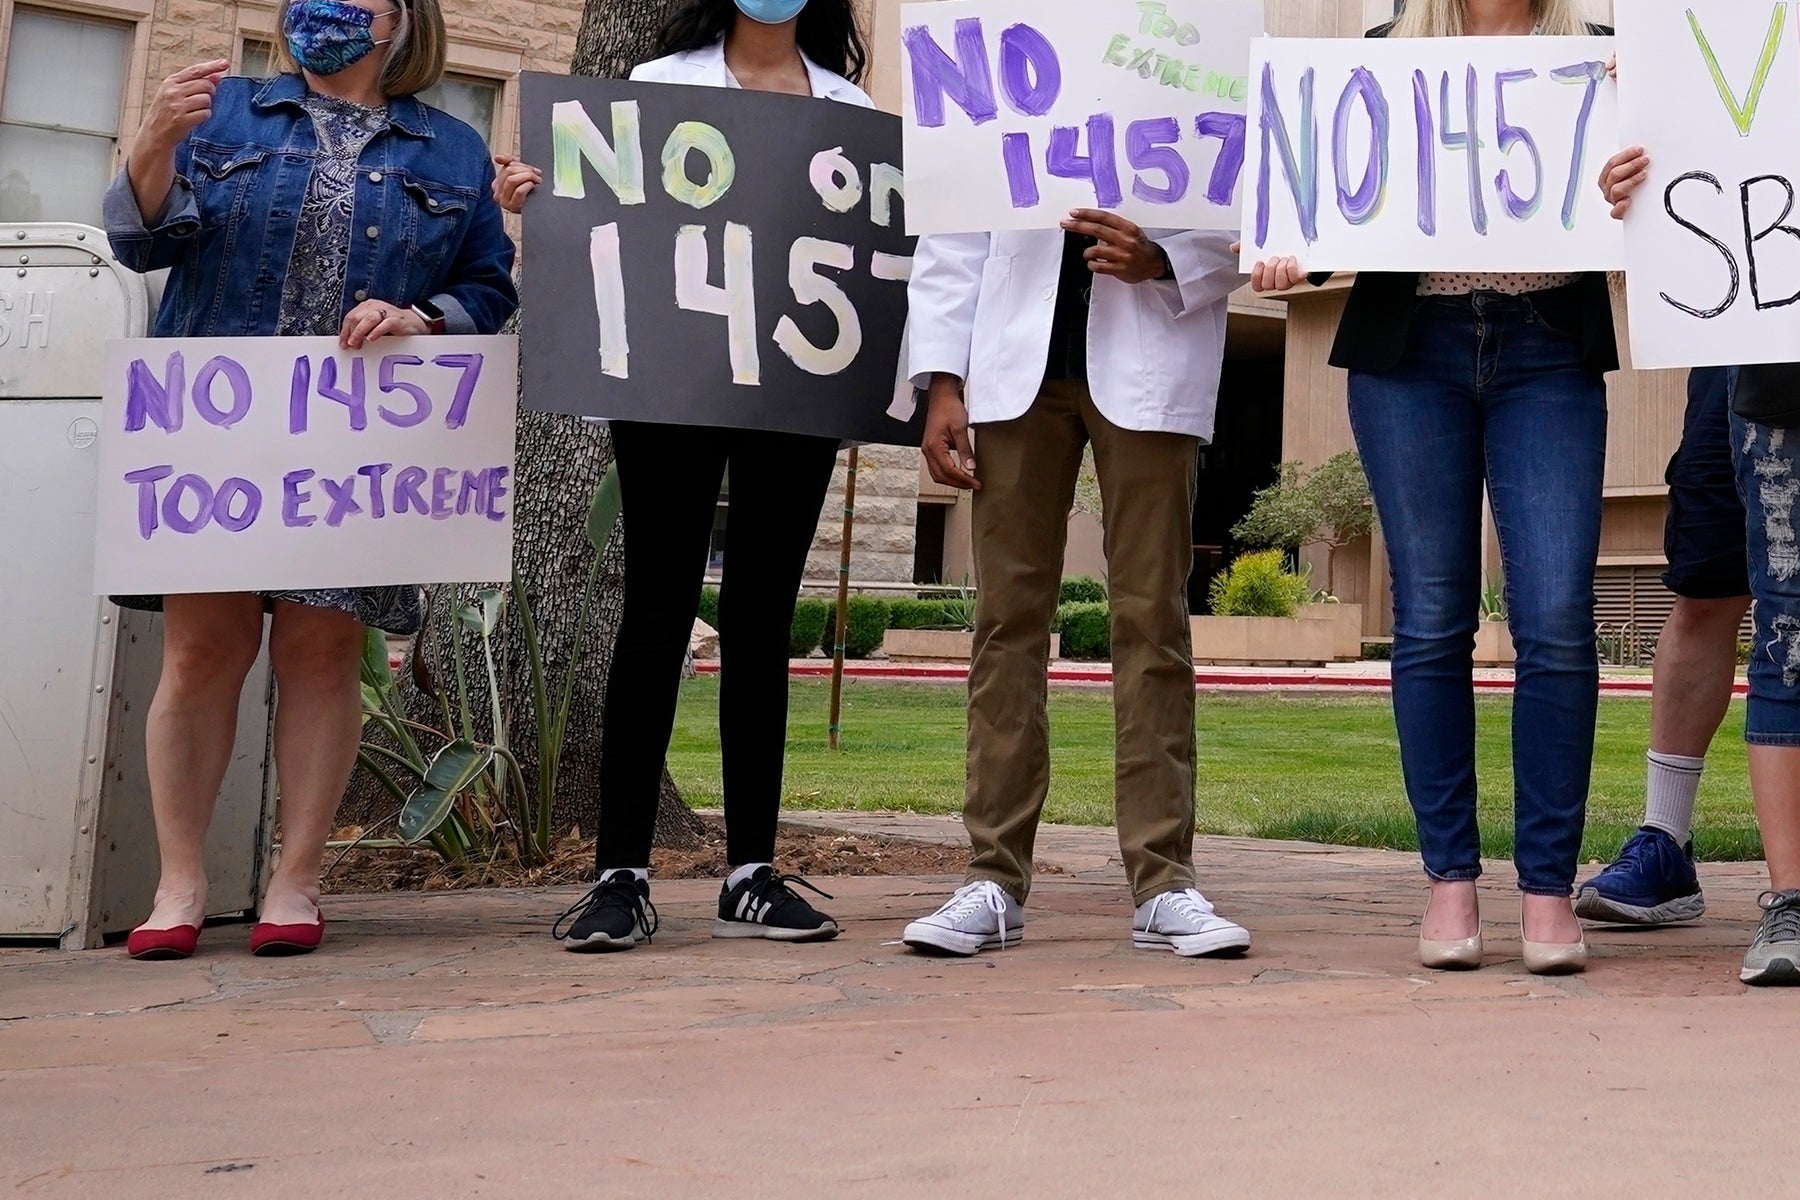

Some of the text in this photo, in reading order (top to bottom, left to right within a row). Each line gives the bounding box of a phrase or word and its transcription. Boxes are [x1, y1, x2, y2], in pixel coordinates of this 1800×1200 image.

[902, 17, 1063, 127] NO
[1102, 32, 1247, 102] EXTREME
[553, 100, 736, 210] NO
[1001, 112, 1246, 210] 1457
[588, 222, 918, 423] 1457
[124, 351, 486, 436] NO 1457
[123, 464, 510, 541] TOO EXTREME
